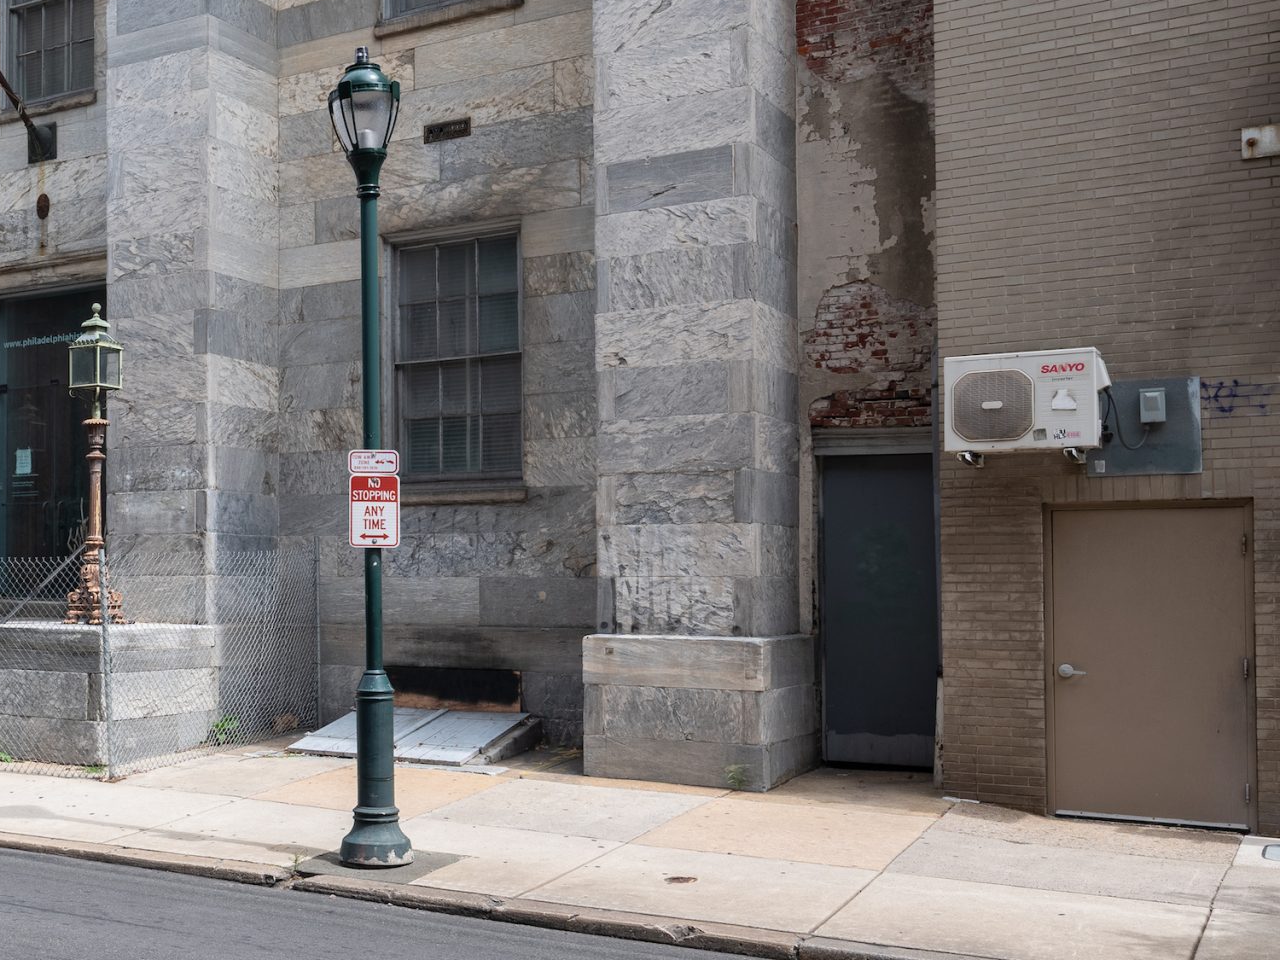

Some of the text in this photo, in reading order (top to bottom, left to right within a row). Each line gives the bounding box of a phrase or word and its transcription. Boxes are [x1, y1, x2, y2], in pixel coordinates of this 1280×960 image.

[1041, 362, 1085, 374] SANYO
[368, 478, 380, 488] NO
[352, 490, 396, 500] STOPPING
[364, 506, 385, 516] ANY
[363, 519, 386, 530] TIME
